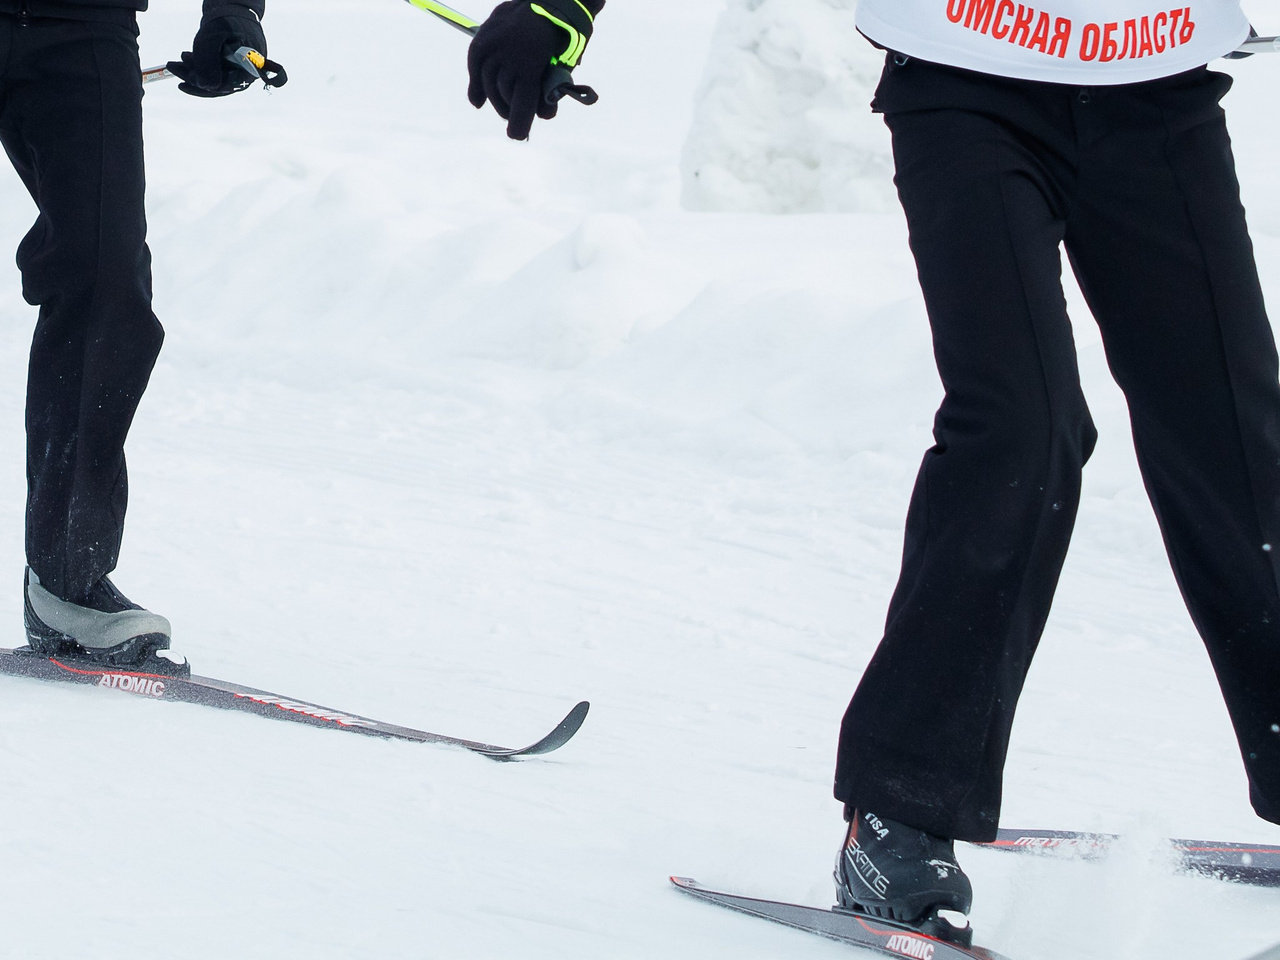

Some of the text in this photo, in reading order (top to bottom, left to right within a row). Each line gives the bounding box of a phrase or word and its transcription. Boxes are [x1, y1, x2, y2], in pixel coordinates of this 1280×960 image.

[1079, 7, 1195, 62] ОБЛАСТЬ
[100, 673, 165, 697] ATOMIC
[886, 934, 934, 960] ATOMIC
